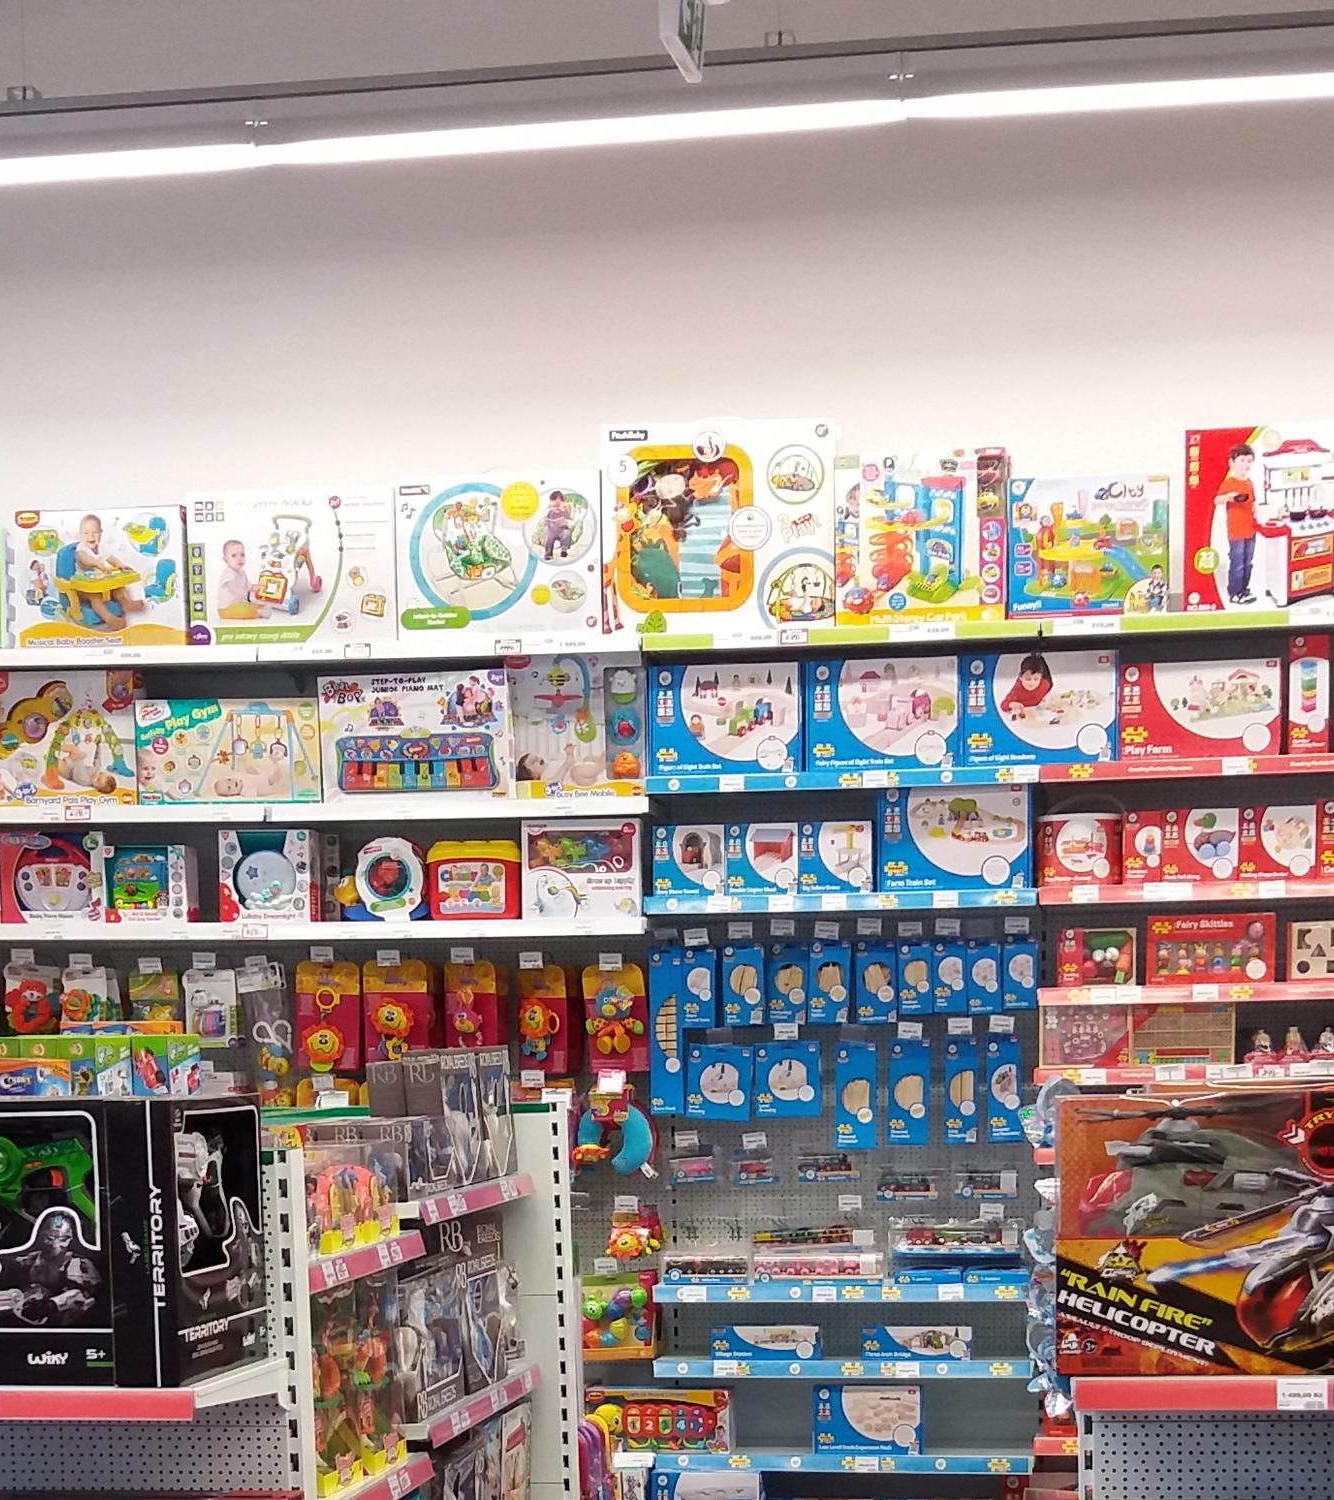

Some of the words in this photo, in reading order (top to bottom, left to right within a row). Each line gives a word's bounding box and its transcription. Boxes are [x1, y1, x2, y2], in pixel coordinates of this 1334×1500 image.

[27, 638, 53, 646] Musical
[55, 638, 74, 648] Baby
[76, 637, 104, 646] Booster
[105, 636, 123, 646] Seat
[371, 675, 427, 686] STEP-TO-PLAY
[371, 686, 400, 694] JUNIOR
[401, 685, 425, 693] PIANO
[427, 684, 444, 692] MAT
[165, 712, 190, 730] Play
[192, 703, 219, 720] Gym
[1124, 745, 1148, 757] Play
[1150, 743, 1172, 754] Farm
[575, 789, 589, 798] Bee
[590, 788, 615, 797] Mobile
[886, 878, 905, 888] Farm
[905, 877, 923, 887] Train
[924, 877, 937, 887] Set
[1176, 919, 1197, 931] Fairy
[1304, 1111, 1334, 1131] TRY
[440, 1221, 464, 1252] RB
[153, 1186, 167, 1307] TERRITORY
[178, 1316, 231, 1343] TERRITORY
[1057, 1289, 1216, 1357] HELICOPTER
[85, 1349, 107, 1361] 5+
